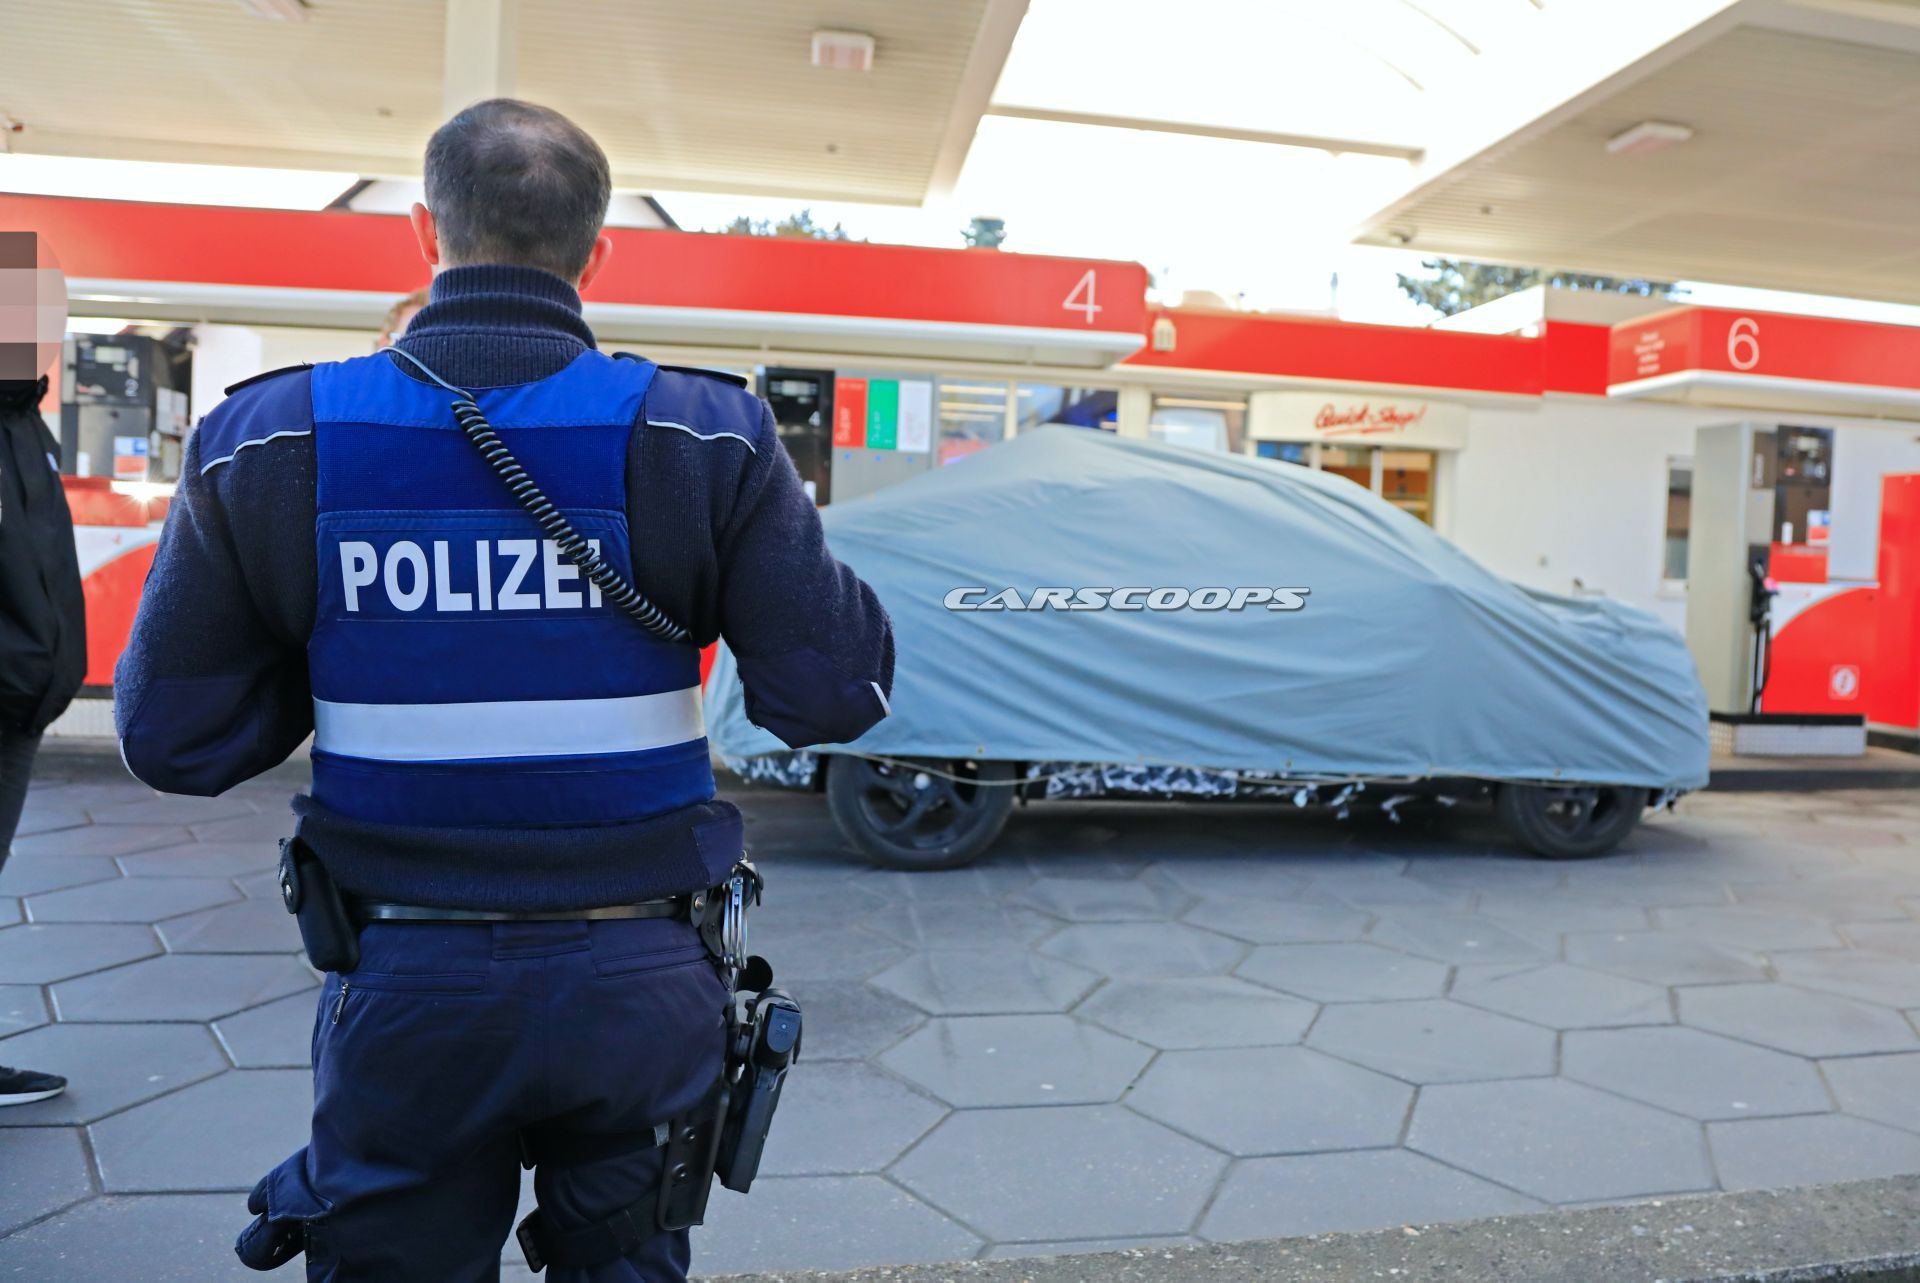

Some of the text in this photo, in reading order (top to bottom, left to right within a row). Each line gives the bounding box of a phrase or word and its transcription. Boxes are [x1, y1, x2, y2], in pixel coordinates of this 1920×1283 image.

[1062, 269, 1102, 324] 4
[1727, 317, 1760, 371] 6
[125, 379, 139, 397] 2
[808, 410, 821, 427] 4
[338, 538, 603, 612] POLIZEI
